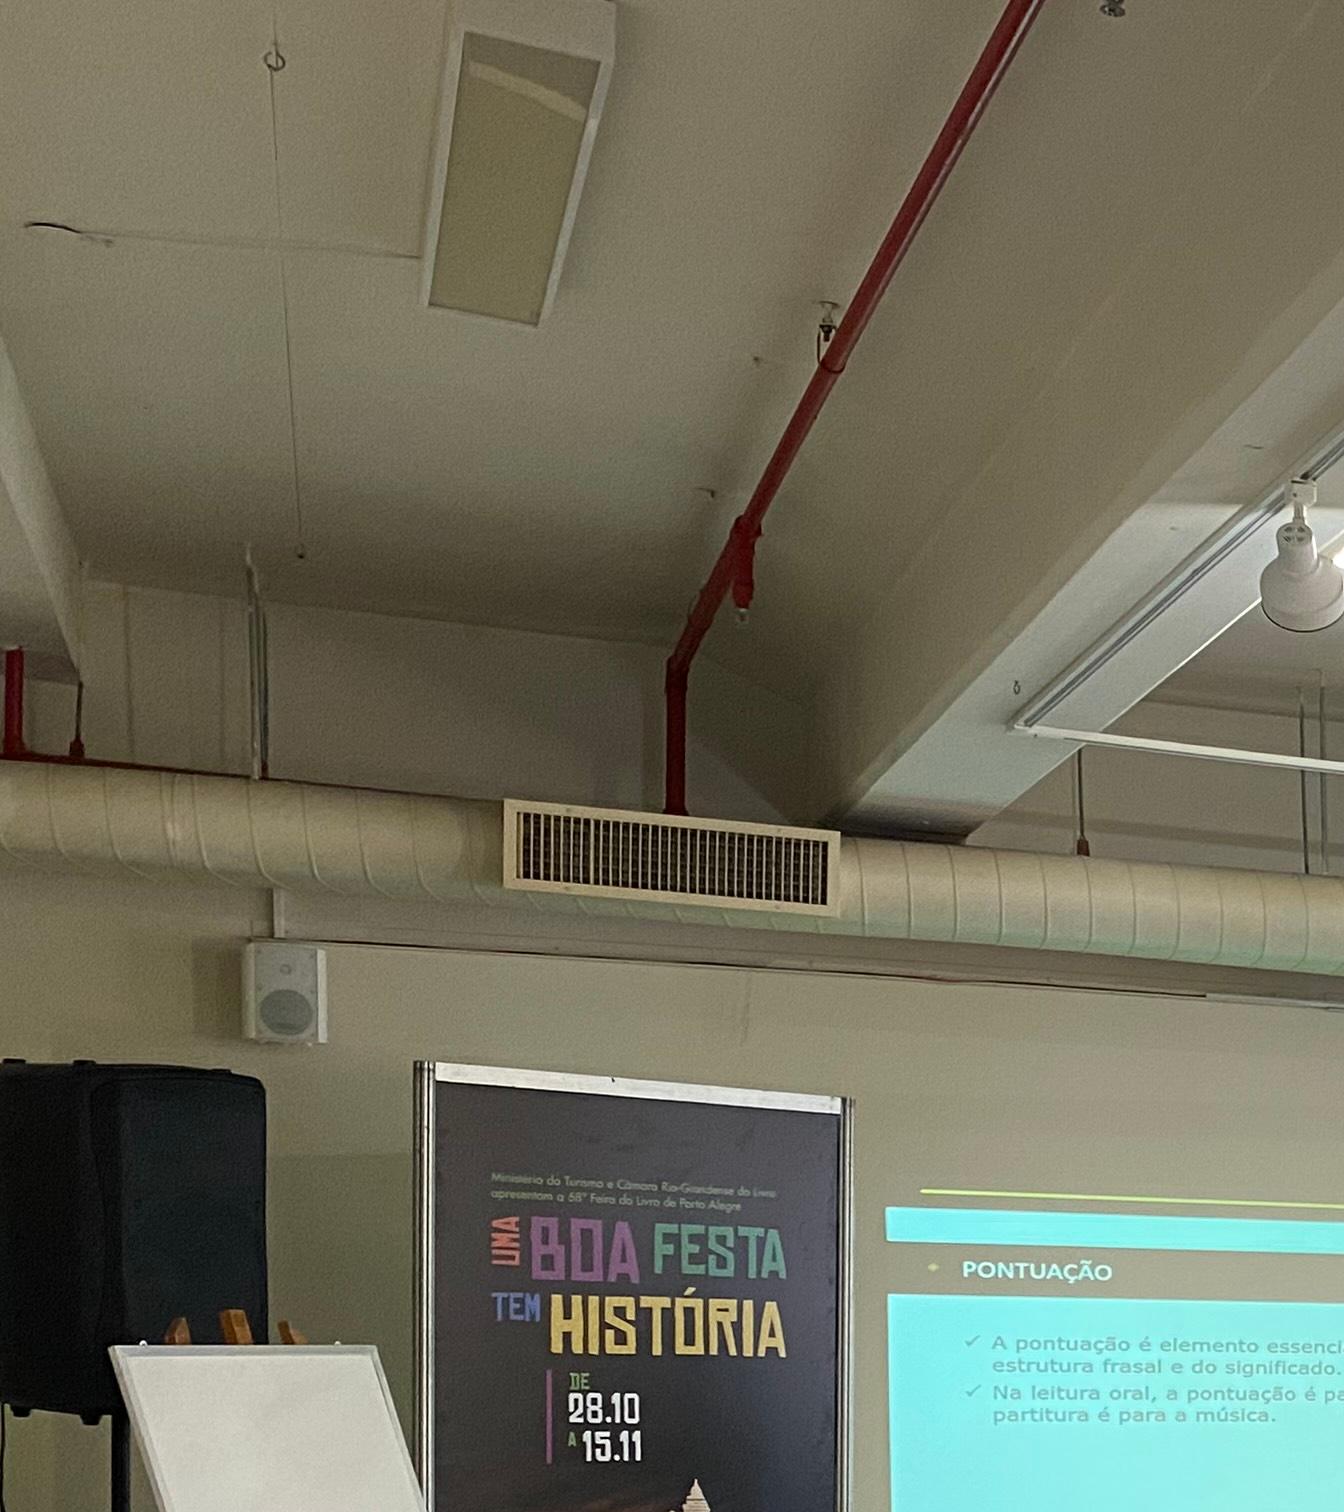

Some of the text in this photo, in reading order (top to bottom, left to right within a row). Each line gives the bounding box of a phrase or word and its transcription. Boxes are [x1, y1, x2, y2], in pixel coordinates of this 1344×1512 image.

[547, 1175, 560, 1186] do
[564, 1176, 604, 1188] Turismo
[737, 1185, 751, 1196] do
[590, 1193, 616, 1205] Feira
[618, 1194, 633, 1206] do
[637, 1196, 660, 1207] Livro
[663, 1197, 676, 1208] de
[680, 1198, 705, 1209] Porto
[707, 1200, 742, 1213] Alegre
[491, 1216, 787, 1284] UMA BOA FESTA
[962, 1259, 1113, 1284] PONTUAÇÃO
[491, 1287, 787, 1358] TEM HISTÓRIA
[991, 1336, 1008, 1350] A
[1016, 1337, 1131, 1355] pontuação
[1139, 1335, 1152, 1352] é
[1160, 1338, 1259, 1353] elemento
[993, 1359, 1342, 1378] estrutura frasal e do significado.
[569, 1372, 590, 1391] DE
[993, 1386, 1022, 1401] Na
[1031, 1385, 1100, 1401] leitura
[1109, 1386, 1156, 1403] oral,
[1166, 1390, 1178, 1402] a
[1187, 1386, 1296, 1404] pontuação
[1304, 1386, 1316, 1401] é
[568, 1392, 641, 1425] 28.10
[993, 1407, 1277, 1426] partitura é para a música.
[568, 1430, 642, 1462] A 15.11
